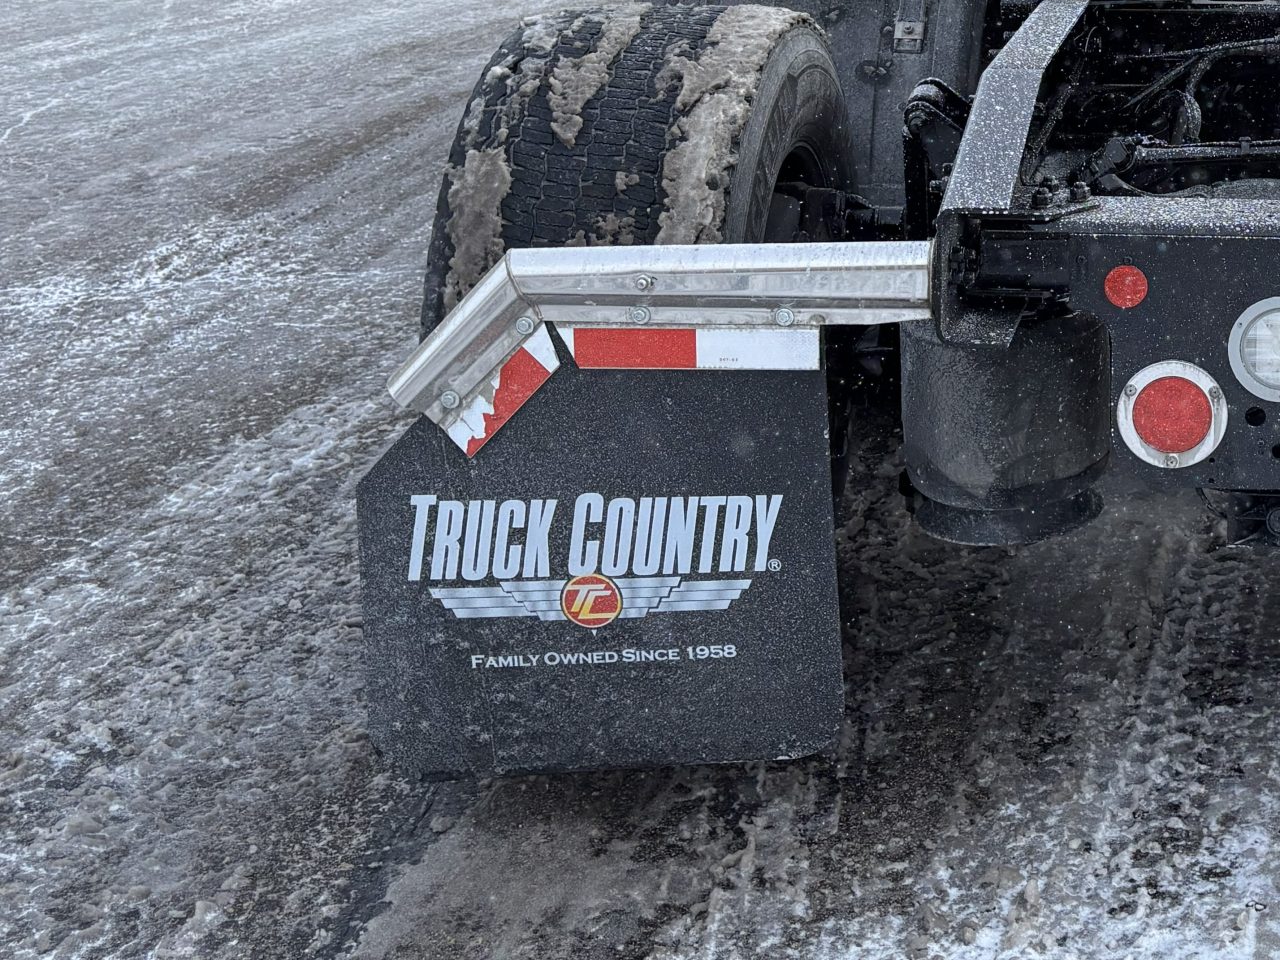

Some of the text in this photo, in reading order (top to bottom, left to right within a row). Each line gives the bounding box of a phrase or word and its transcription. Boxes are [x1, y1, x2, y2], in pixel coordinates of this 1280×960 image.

[407, 492, 784, 582] TRUCK COUNTRY
[470, 645, 738, 670] FAMILY OWNED SINCE 1958
